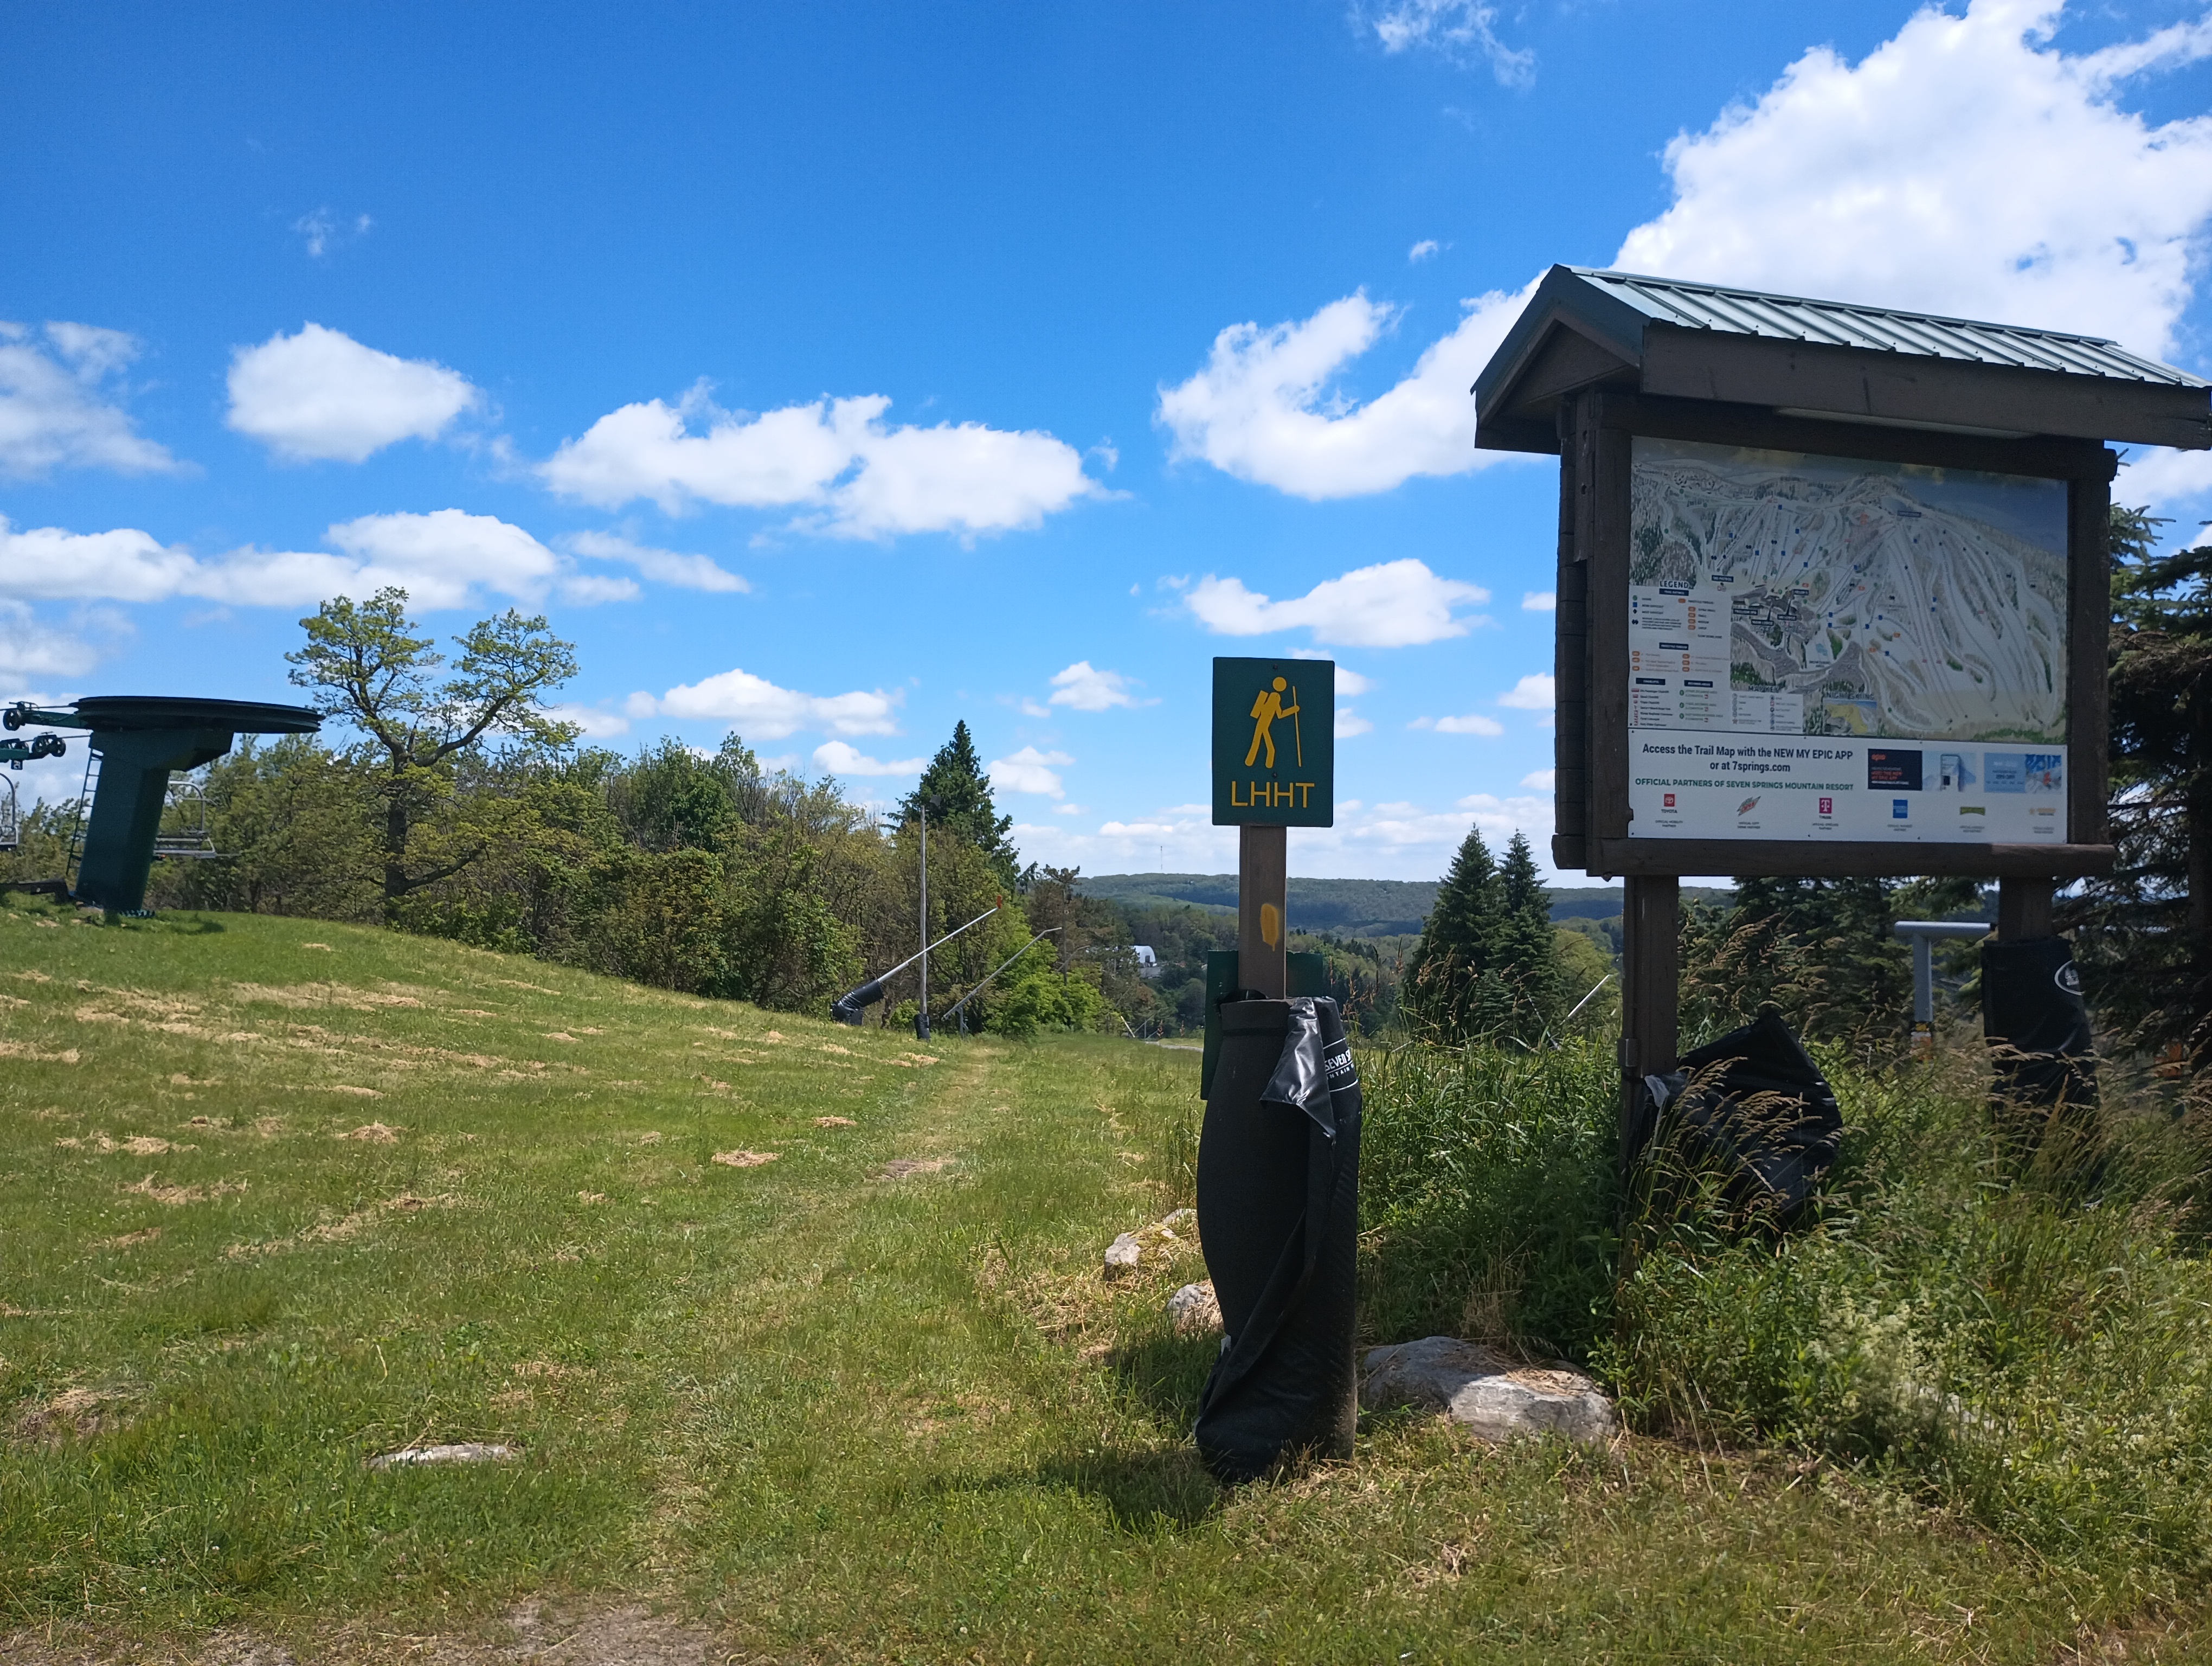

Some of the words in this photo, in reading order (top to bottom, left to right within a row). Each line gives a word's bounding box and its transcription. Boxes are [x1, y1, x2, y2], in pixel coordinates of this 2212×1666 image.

[1660, 580, 1689, 588] LEGEND
[1642, 743, 1676, 754] Access
[1677, 744, 1693, 755] the
[1694, 745, 1714, 755] Trail
[1716, 746, 1735, 758] Map
[1737, 746, 1756, 757] with
[1758, 747, 1772, 758] the
[1773, 748, 1794, 758] NEW
[1796, 749, 1810, 759] MY
[1812, 749, 1833, 759] EPIC
[1835, 750, 1853, 760] APP
[1709, 761, 1719, 770] or
[1721, 761, 1730, 770] at
[1732, 760, 1791, 773] 7springs.com
[1635, 778, 1671, 786] OFFICIAL
[1231, 781, 1315, 808] LHHT
